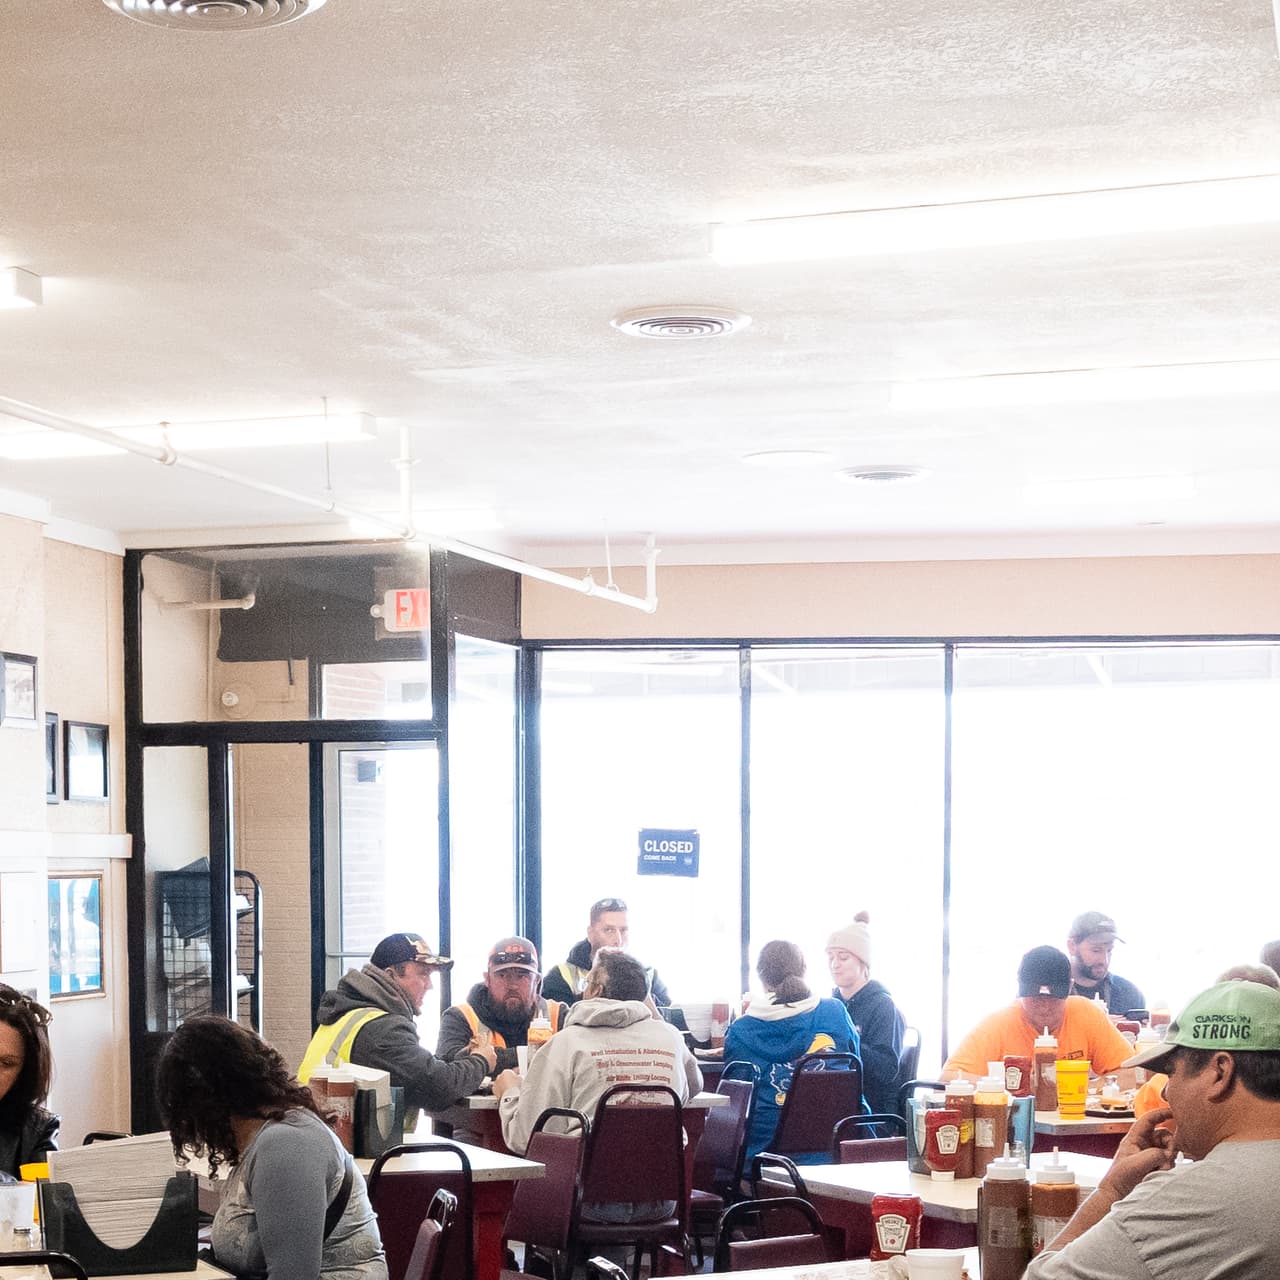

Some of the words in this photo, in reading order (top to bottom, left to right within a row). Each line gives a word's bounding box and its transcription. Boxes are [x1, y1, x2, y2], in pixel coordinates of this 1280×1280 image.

[644, 839, 694, 854] CLOSED
[661, 854, 678, 862] BACK
[1192, 1023, 1252, 1040] STRONG
[604, 1048, 637, 1056] Installation
[632, 1074, 651, 1083] Utility
